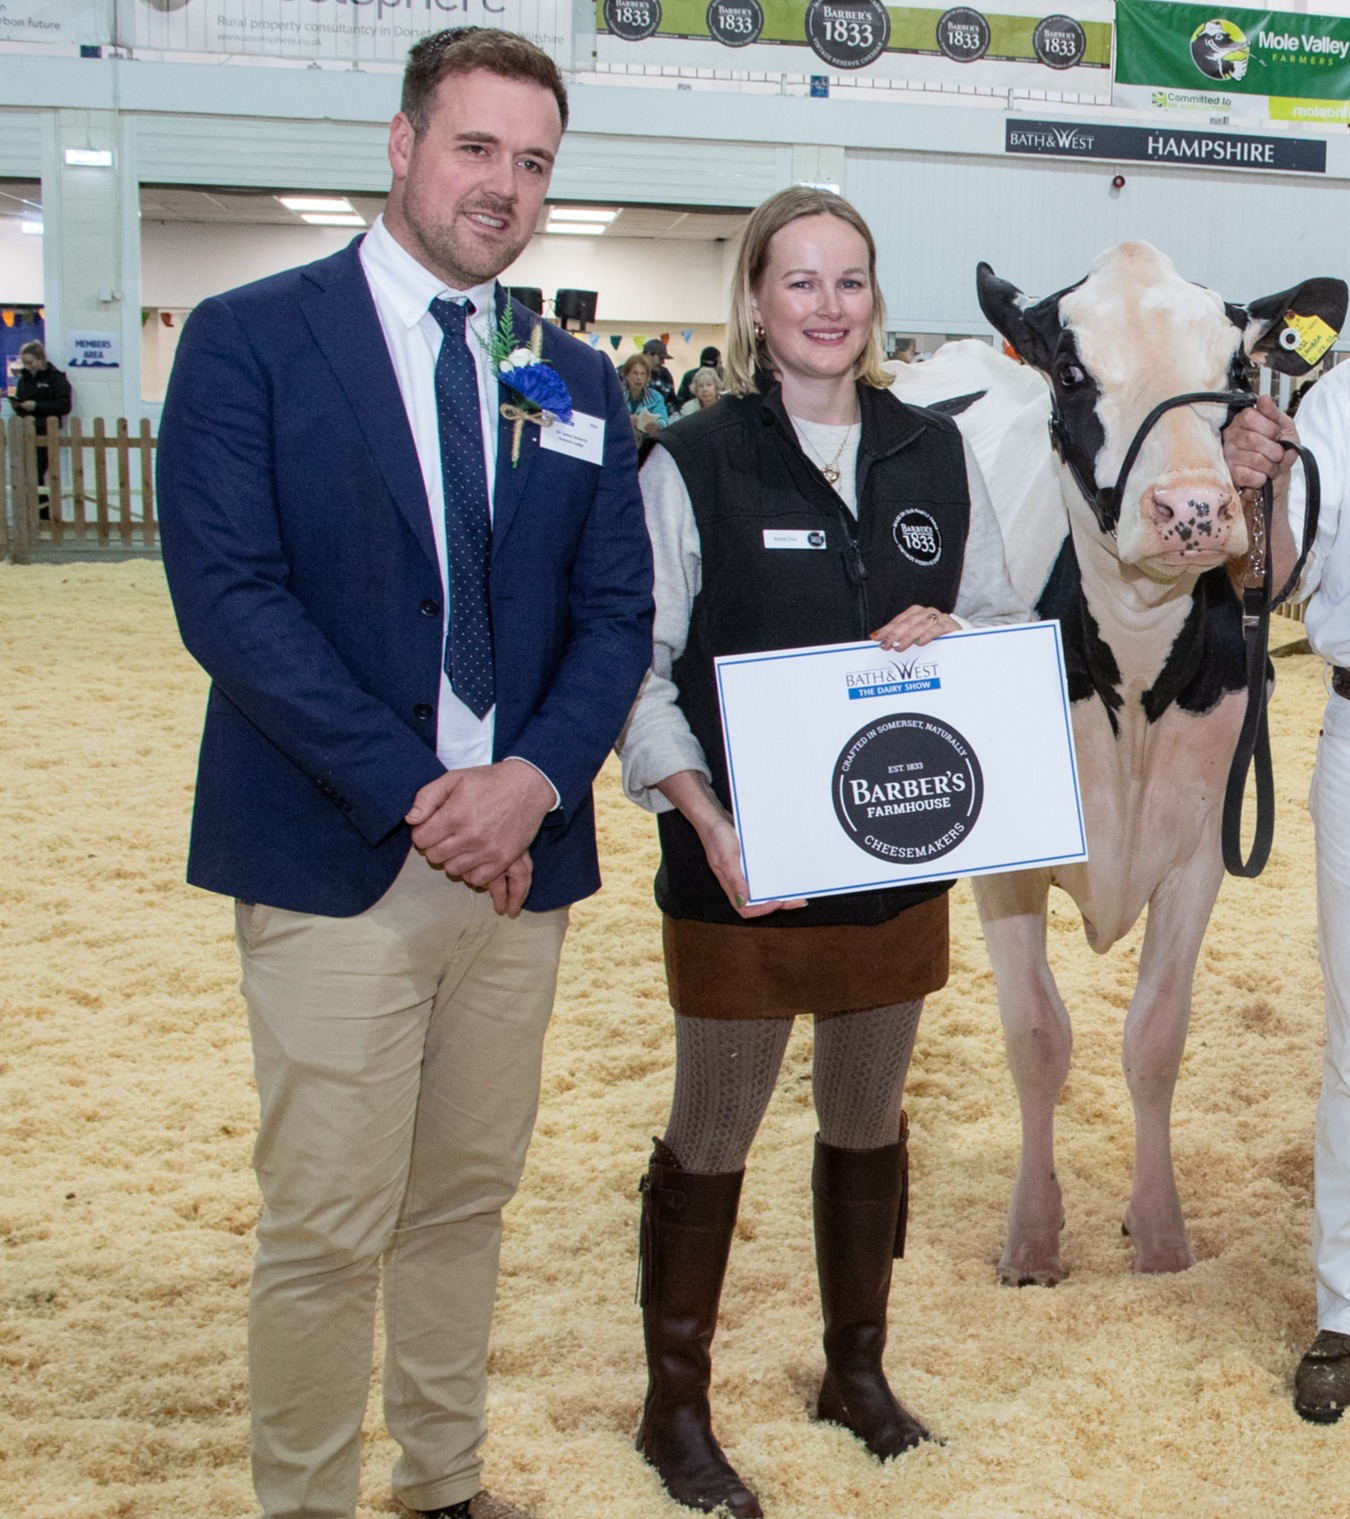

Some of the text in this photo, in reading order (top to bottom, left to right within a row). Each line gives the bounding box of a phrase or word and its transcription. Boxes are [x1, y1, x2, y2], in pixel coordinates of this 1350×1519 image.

[615, 7, 650, 26] 1833
[718, 5, 752, 15] BARBER'S
[823, 6, 872, 21] BARBER'S
[27, 17, 61, 30] future
[217, 15, 247, 27] Rural
[250, 19, 300, 32] property
[380, 26, 391, 36] in
[718, 14, 752, 33] 1833
[947, 21, 980, 32] BARBER'S
[823, 20, 873, 47] 1833
[947, 30, 980, 49] 1833
[832, 57, 860, 67] RESERVE
[860, 41, 883, 63] CHEDDAR
[1043, 38, 1076, 57] 1833
[1258, 31, 1350, 59] Mole Valley
[1272, 53, 1334, 67] FARMERS
[1168, 92, 1232, 106] Committed to
[1148, 136, 1275, 163] HAMPSHIRE
[75, 340, 111, 348] MEMBERS
[83, 350, 104, 359] AREA
[903, 533, 937, 554] 1833
[845, 657, 939, 687] BATH&WEST
[858, 681, 931, 697] THE DAIRY SHOW
[841, 720, 968, 772] CRAFTED IN SOMERSET, NATURALLY
[888, 762, 924, 774] EST. 1833
[849, 771, 966, 805] BARBER'S
[867, 797, 951, 818] FARMHOUSE
[864, 822, 965, 858] CHEESEMAKERS
